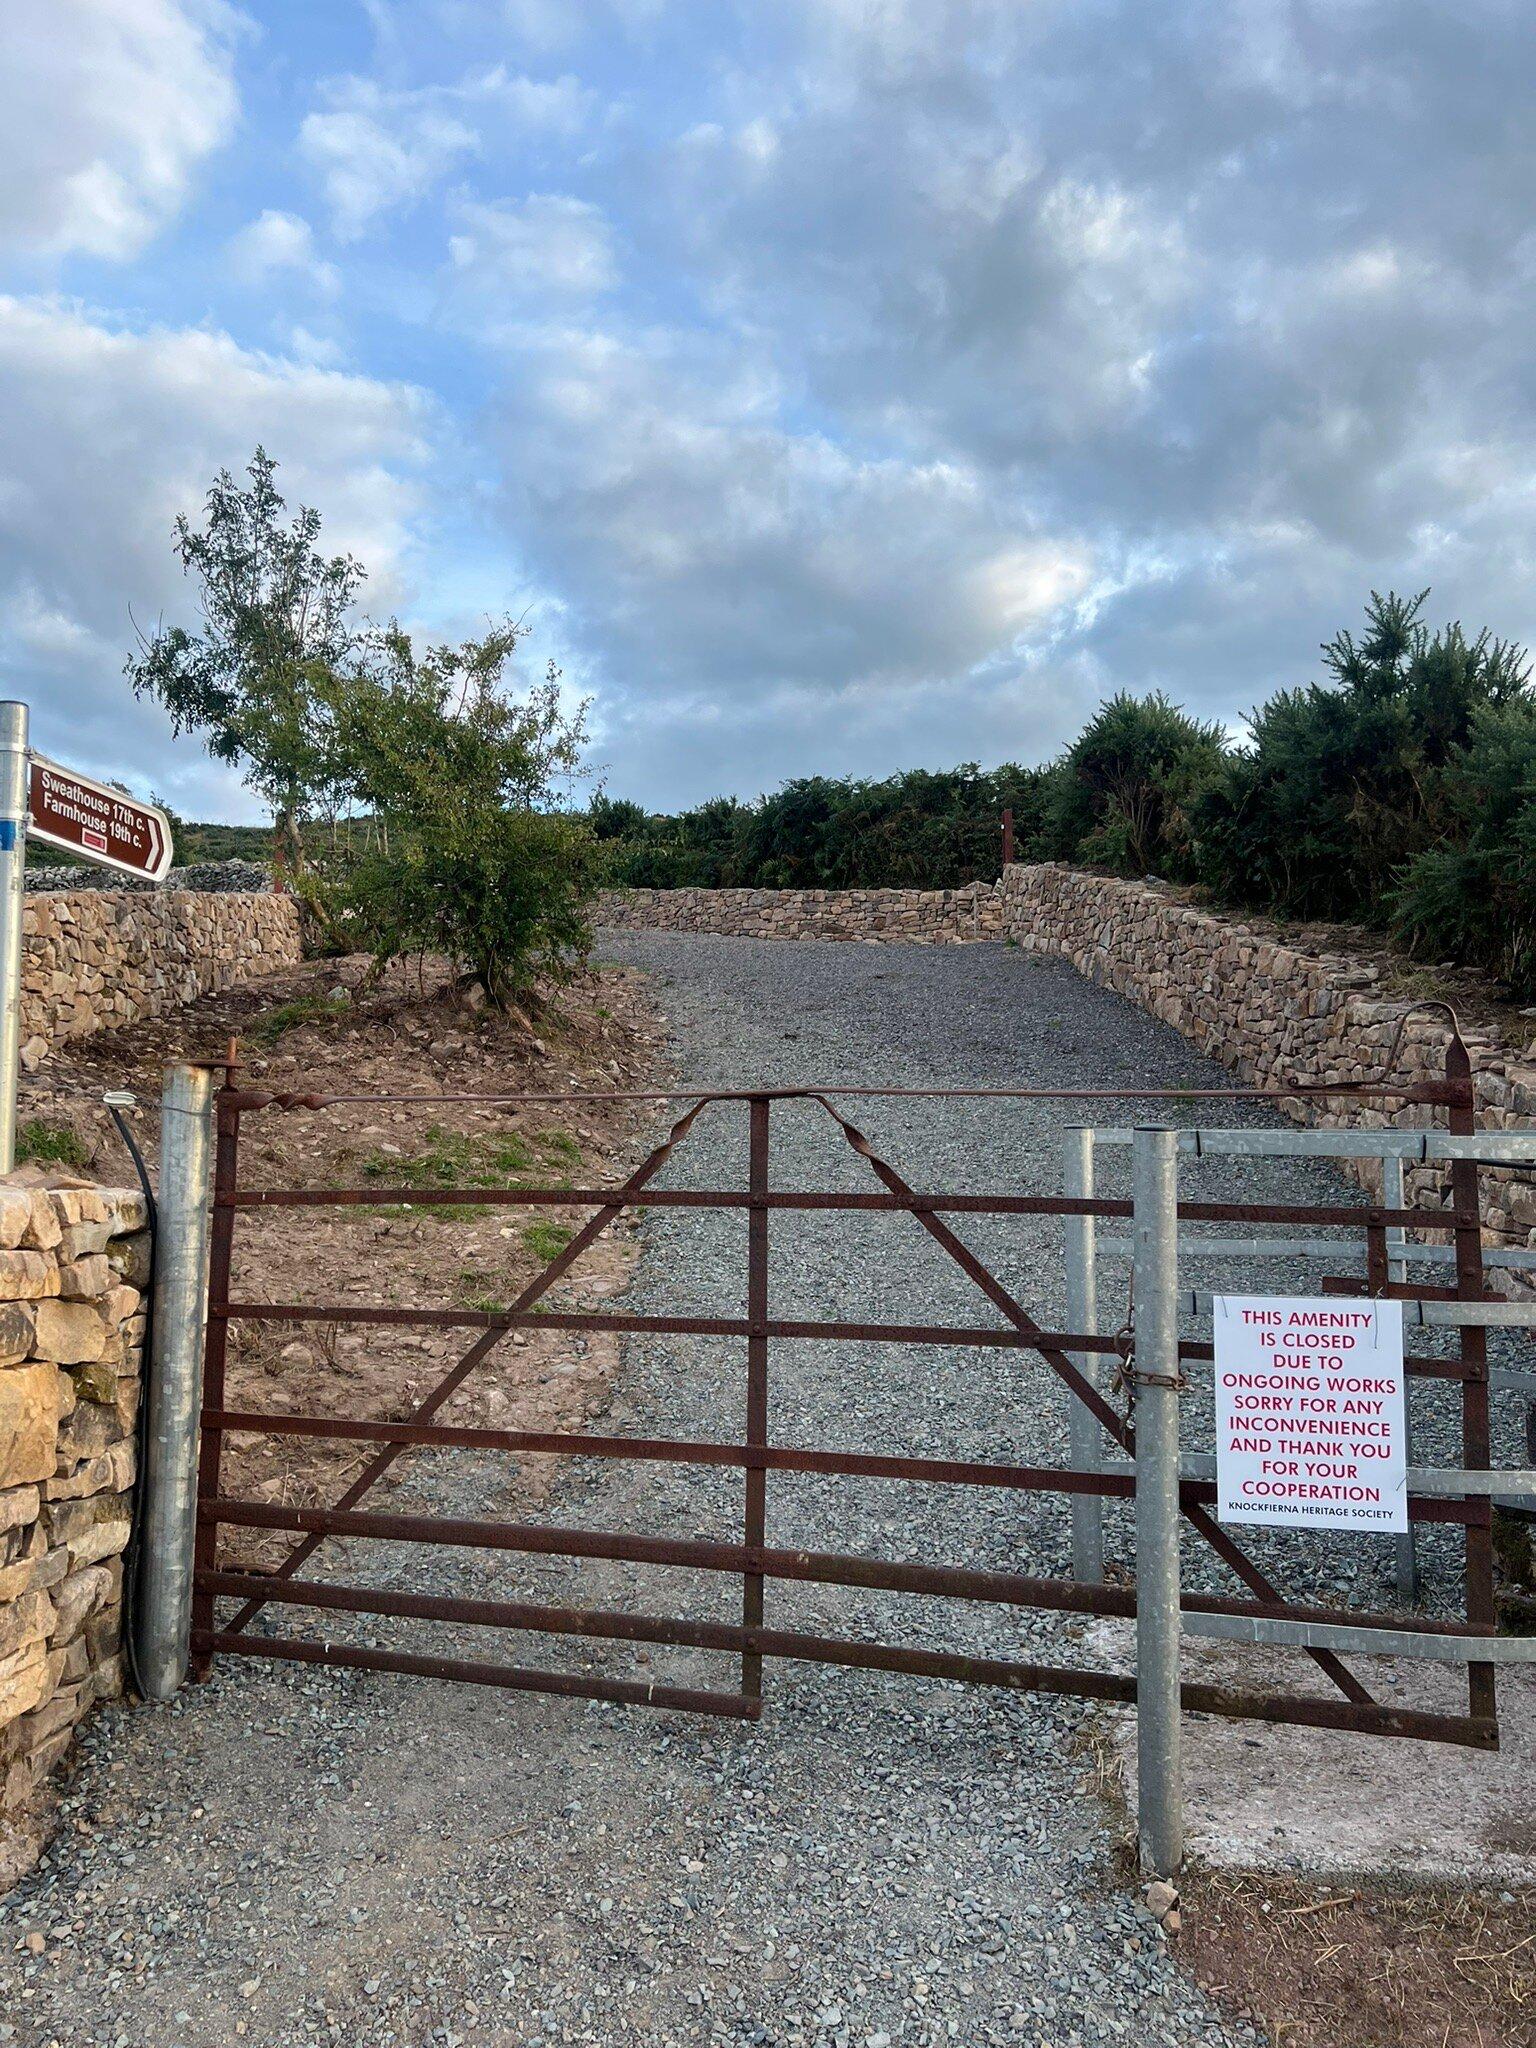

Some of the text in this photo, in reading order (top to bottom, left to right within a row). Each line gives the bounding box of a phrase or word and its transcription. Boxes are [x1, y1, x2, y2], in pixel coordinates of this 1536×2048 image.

[41, 770, 145, 832] Sweathouse 17th c.
[43, 792, 107, 833] Farmhouse
[109, 821, 131, 844] 19th
[132, 835, 142, 848] c.
[1241, 1310, 1372, 1328] THIS AMENITY
[1260, 1332, 1355, 1349] IS CLOSED
[1273, 1353, 1343, 1371] DUE TO
[1222, 1373, 1396, 1394] ONGOING WORKS
[1234, 1394, 1383, 1415] SORRY FOR ANY
[1229, 1416, 1391, 1438] INCONVENIENCE
[1229, 1437, 1391, 1459] AND THANK YOU
[1262, 1460, 1358, 1479] FOR YOUR
[1242, 1480, 1380, 1502] COOPERATION
[1228, 1501, 1394, 1520] KNOCKFIERNA HERITAGE SOCIETY
